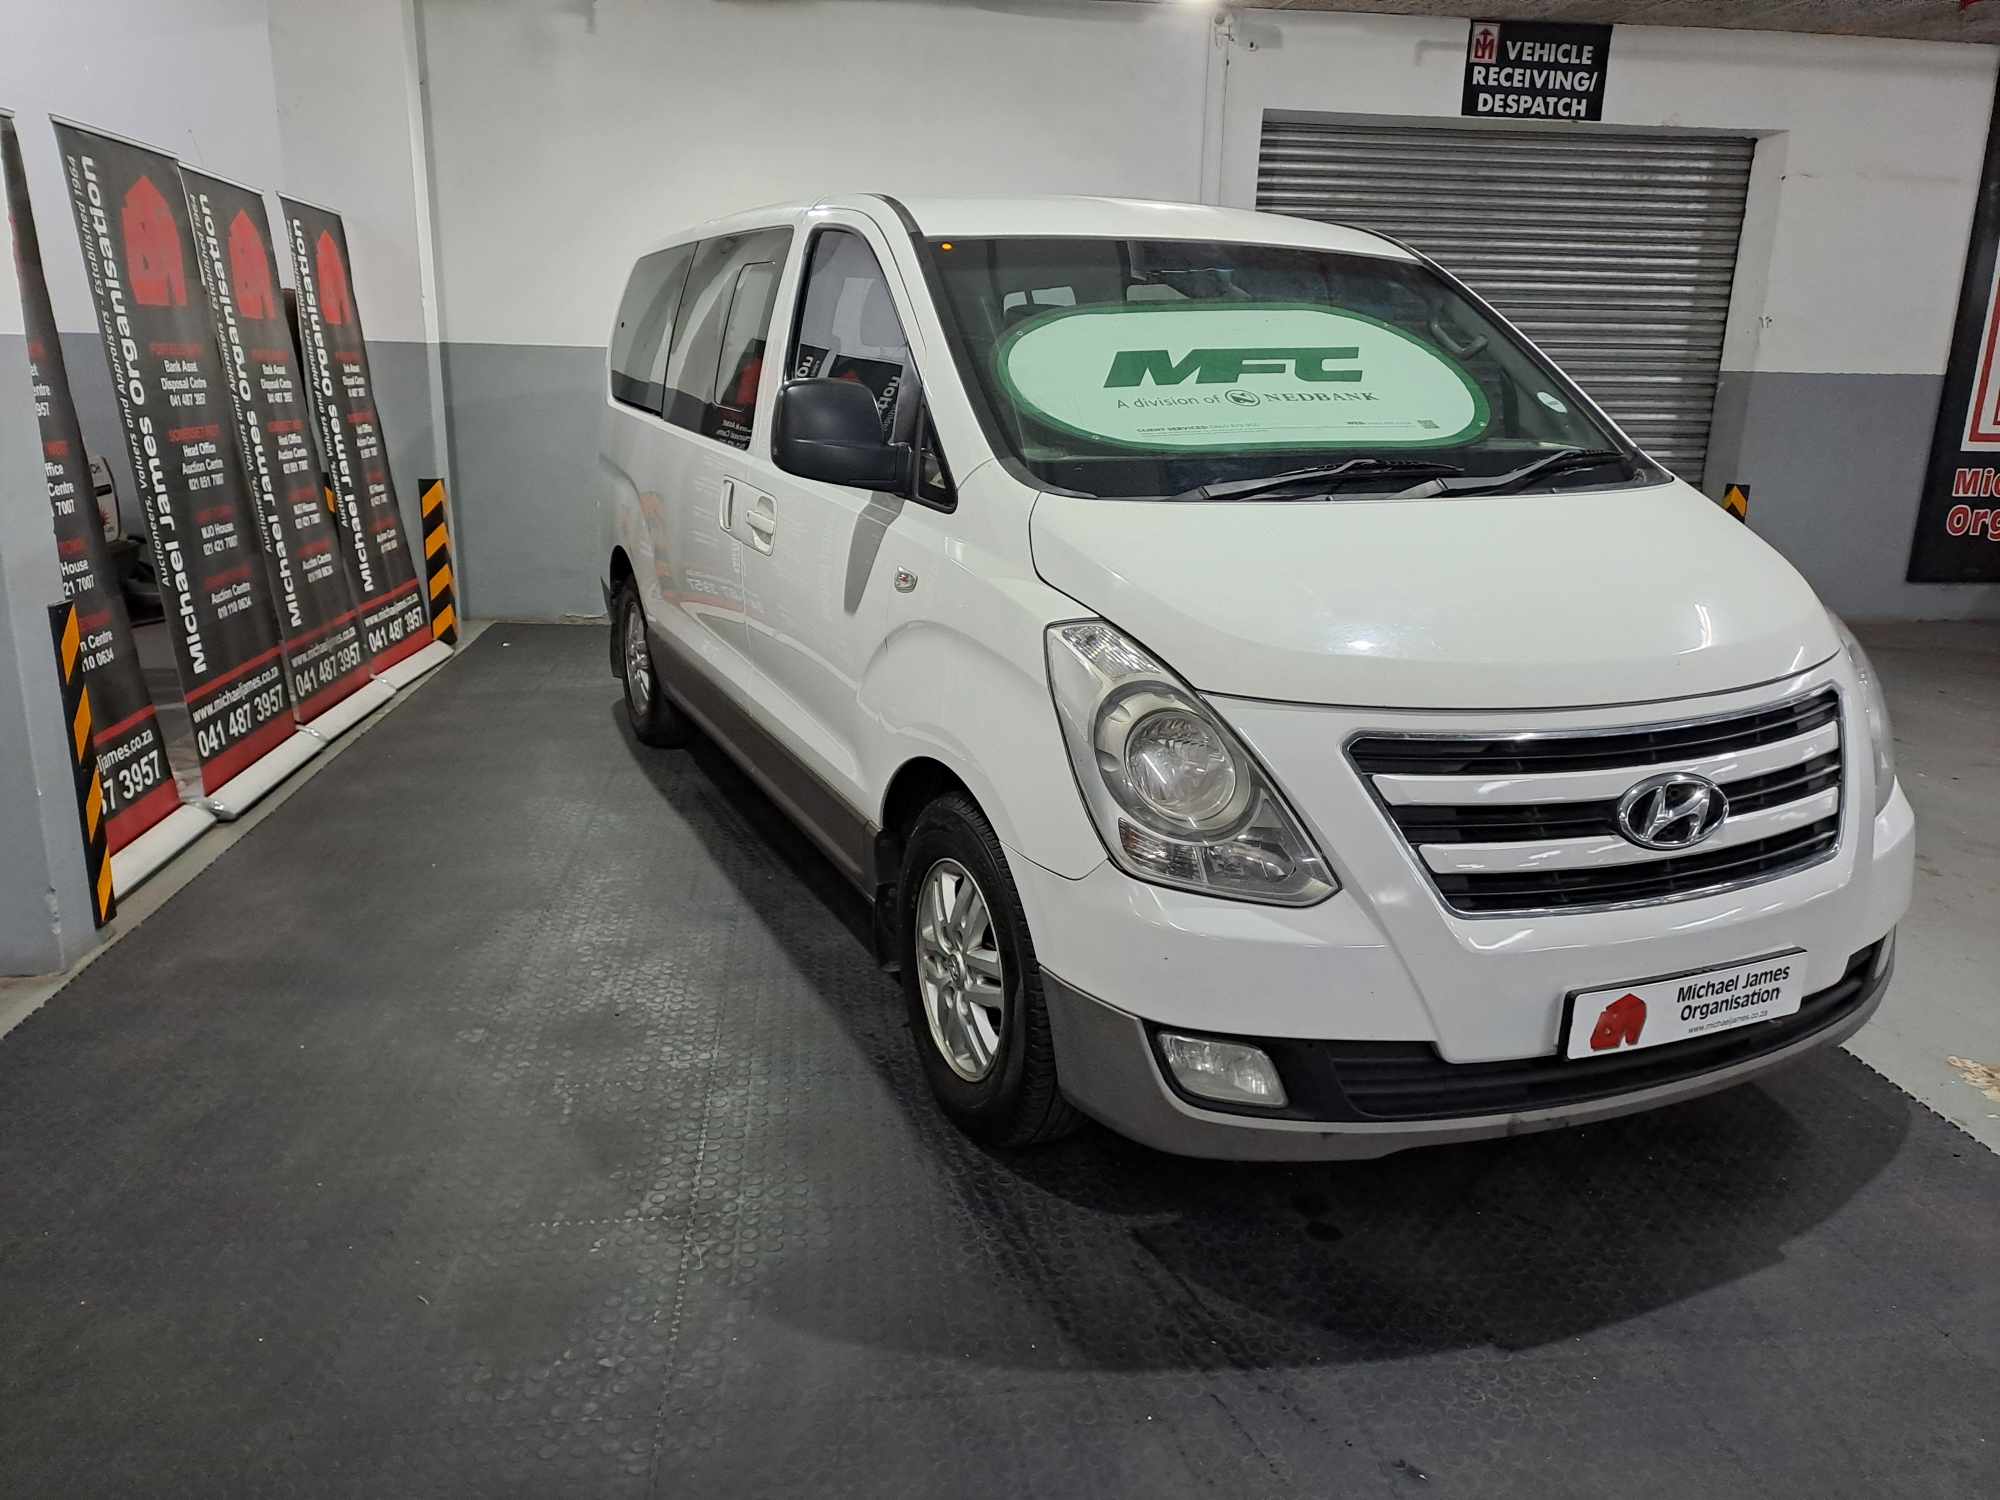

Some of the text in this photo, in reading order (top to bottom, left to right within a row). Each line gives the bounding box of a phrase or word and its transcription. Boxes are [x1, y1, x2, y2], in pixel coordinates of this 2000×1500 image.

[1472, 65, 1598, 92] RECEIVING/
[1506, 41, 1595, 65] VEHICLE
[1477, 92, 1588, 118] DESPATCH
[199, 193, 252, 401] Organisation
[292, 218, 333, 397] Organisation
[102, 310, 128, 394] Appraisers
[1103, 346, 1363, 388] MFC
[81, 155, 207, 675] Michael James Organisation
[119, 400, 134, 428] and
[1117, 392, 1380, 409] A division of NEDBANK
[130, 432, 148, 489] Valuers
[247, 410, 276, 506] James
[327, 404, 353, 488] James
[60, 559, 89, 577] House
[344, 493, 374, 593] Michael
[267, 515, 303, 628] Michael
[88, 630, 113, 649] Centre
[368, 606, 424, 653] 041 487 3957
[295, 641, 361, 697] 041 487 3957
[197, 683, 284, 757] 041 487 3957
[119, 749, 161, 800] 3957
[1676, 965, 1791, 1003] Michael James
[1680, 987, 1781, 1021] Organisation
